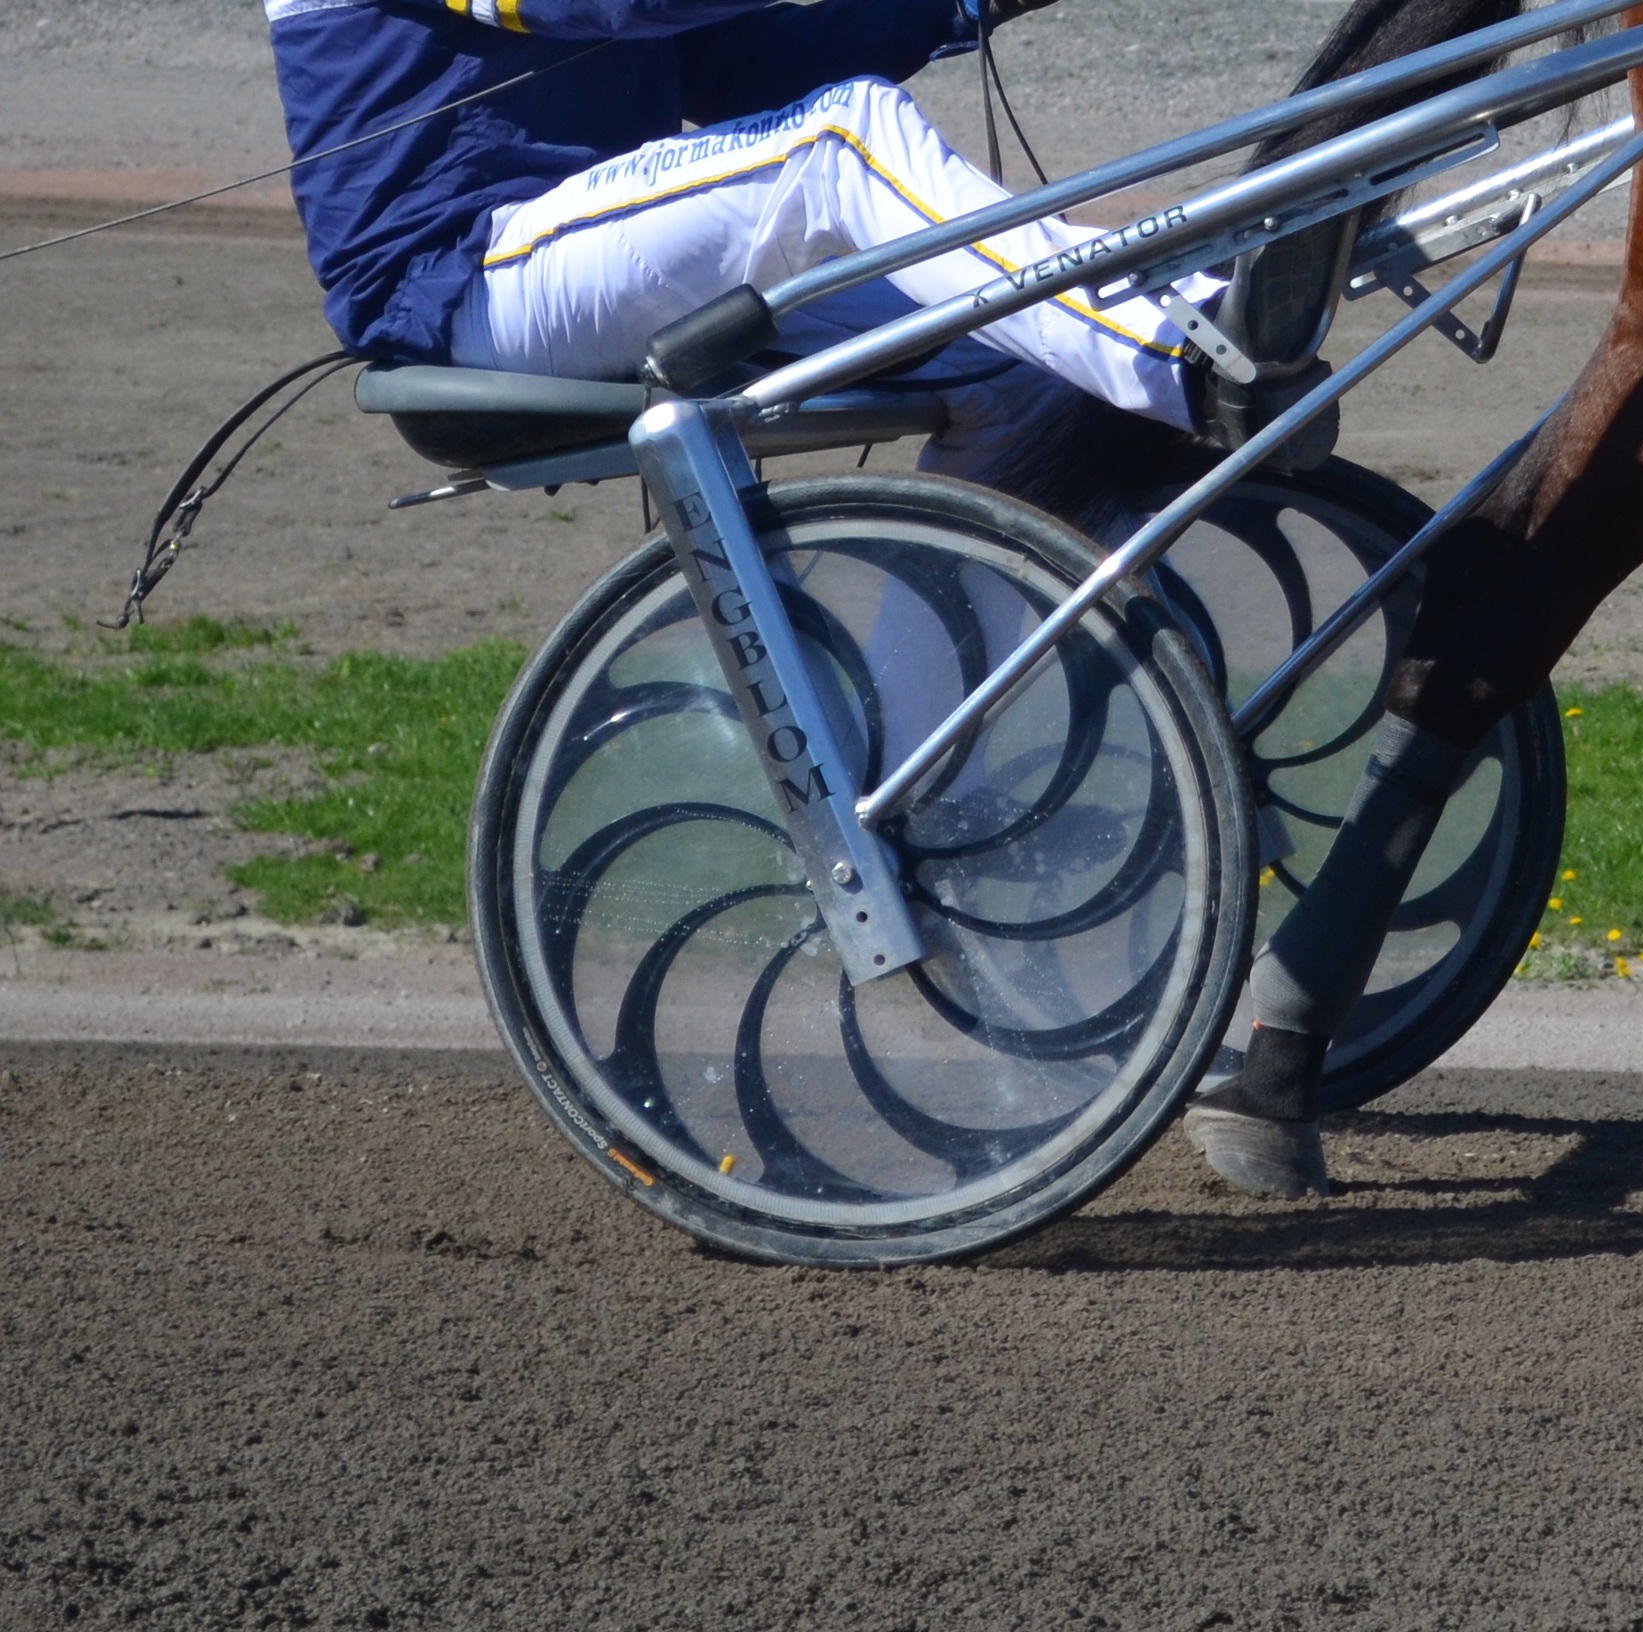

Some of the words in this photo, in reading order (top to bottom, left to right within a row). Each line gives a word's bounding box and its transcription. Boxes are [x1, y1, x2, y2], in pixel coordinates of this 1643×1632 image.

[1005, 205, 1188, 291] VENATOR
[671, 492, 836, 815] ENGBLOM
[541, 1074, 608, 1150] SportCONTACT
